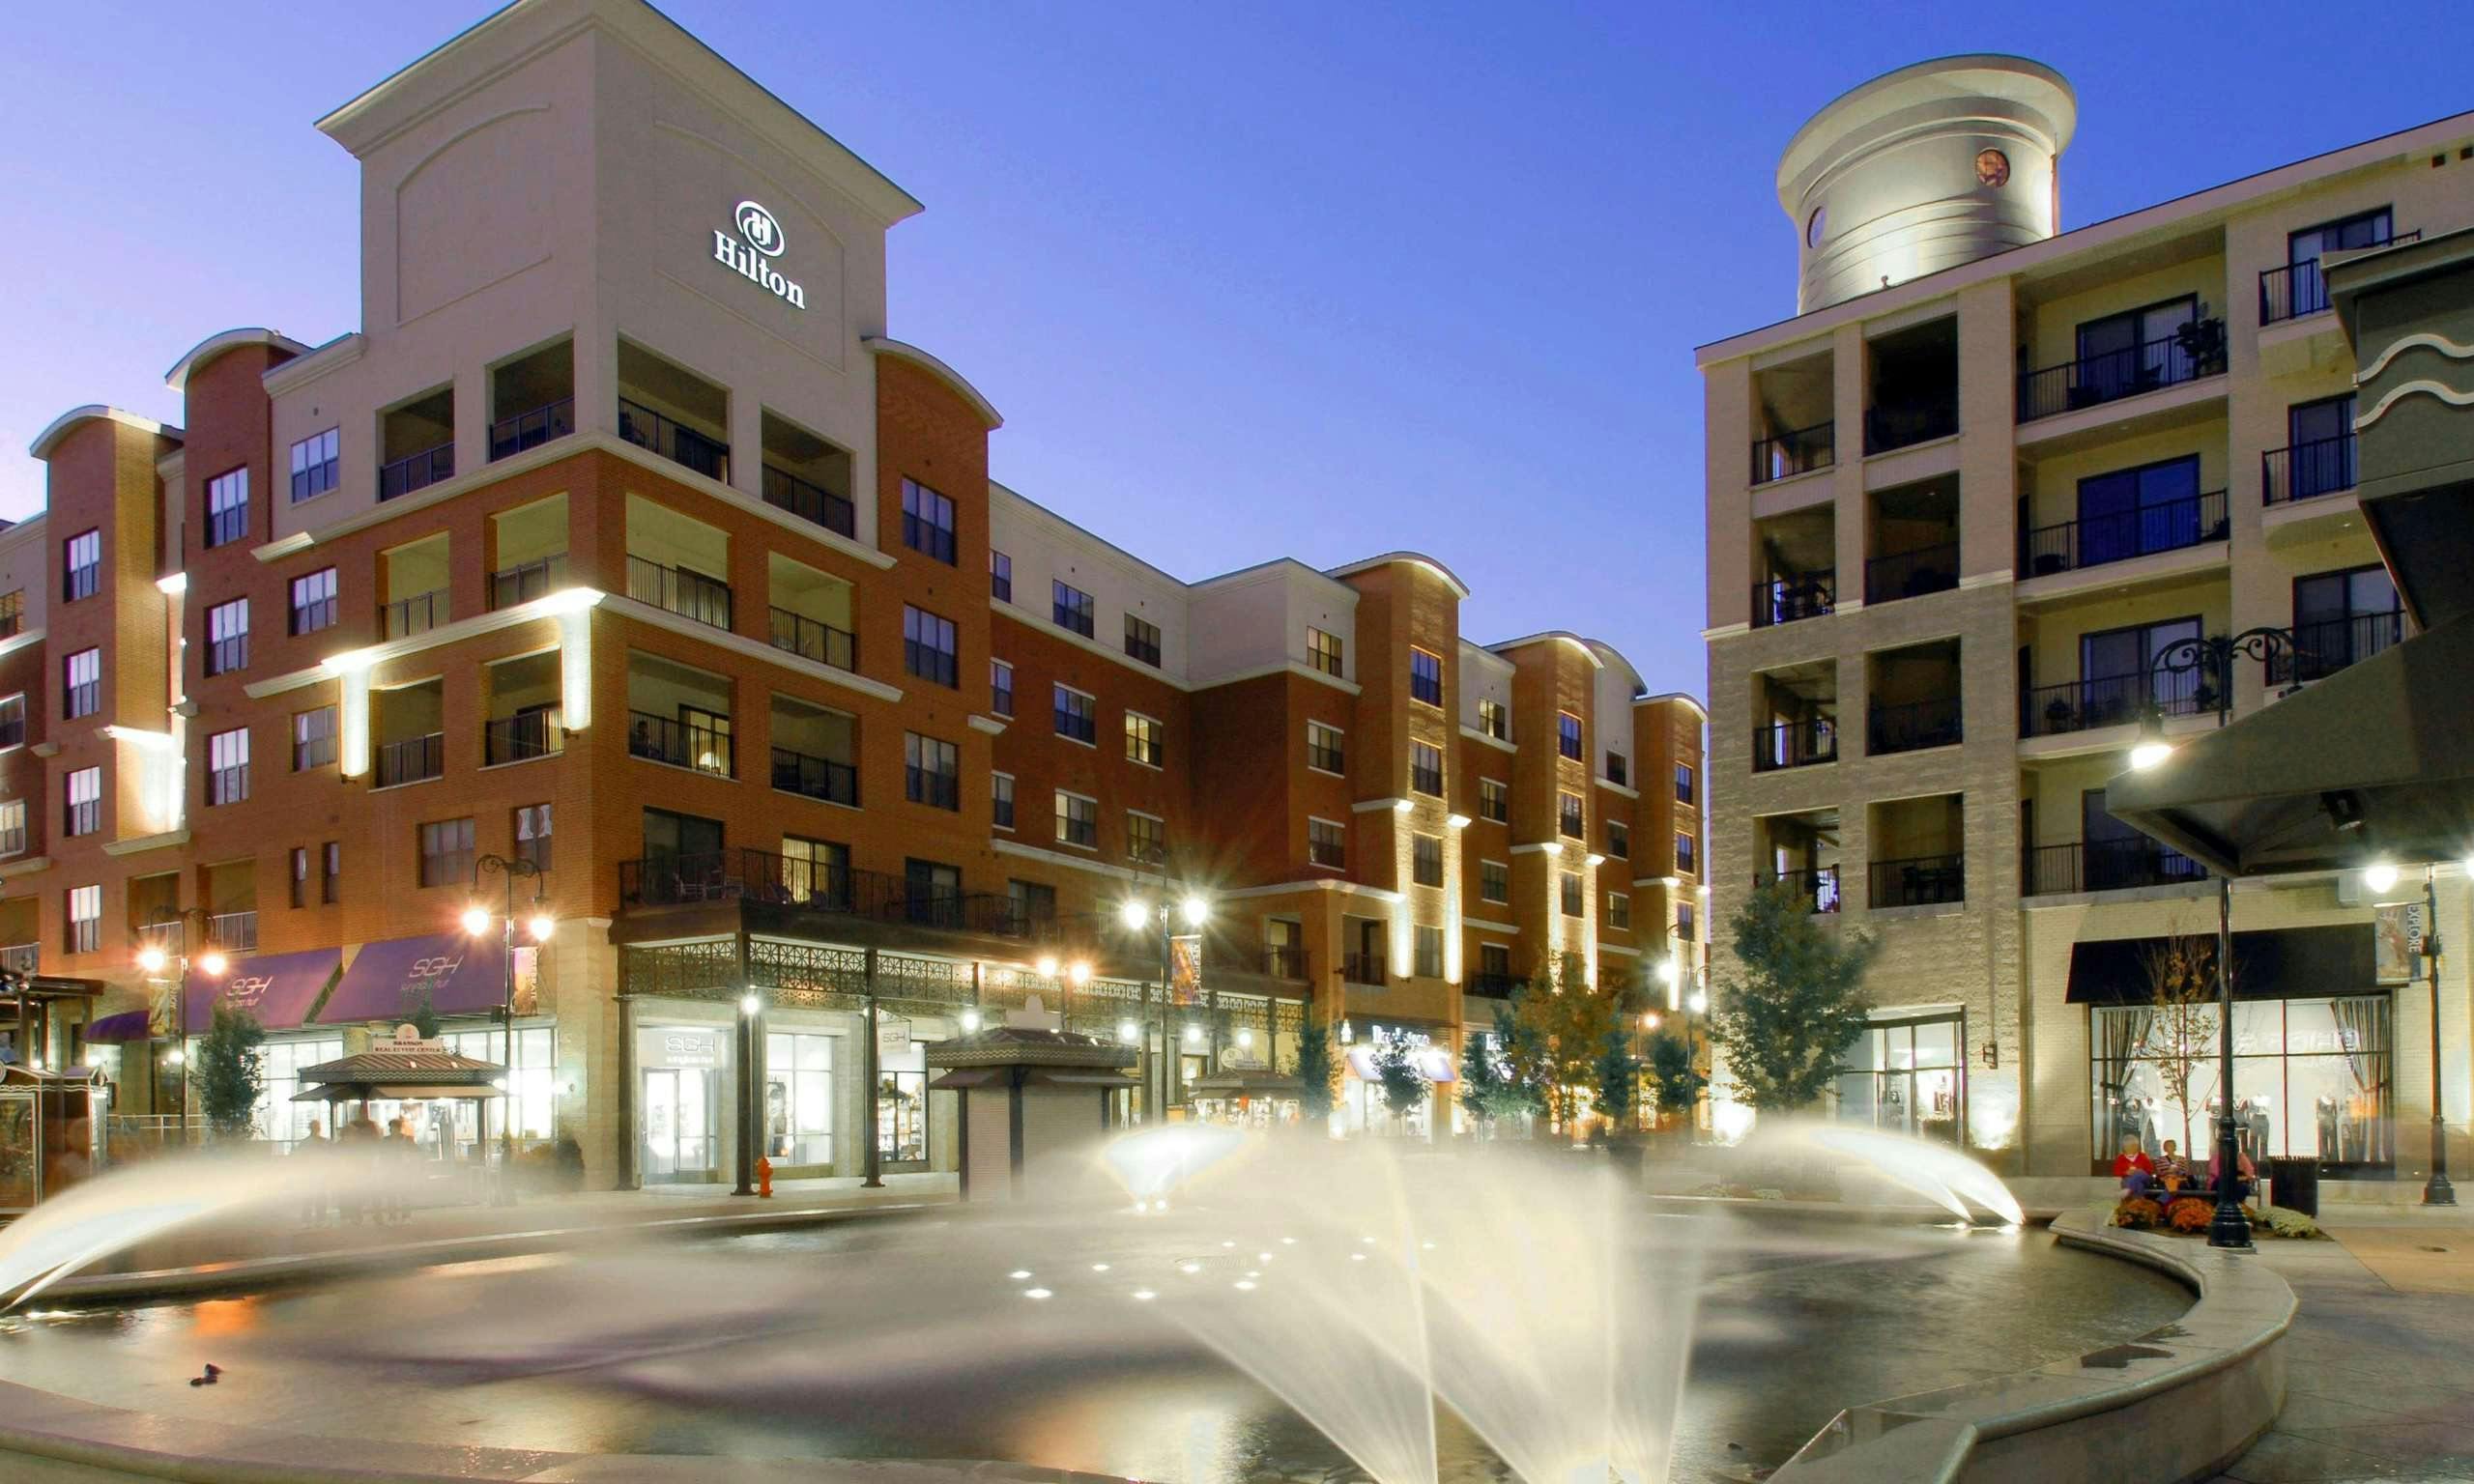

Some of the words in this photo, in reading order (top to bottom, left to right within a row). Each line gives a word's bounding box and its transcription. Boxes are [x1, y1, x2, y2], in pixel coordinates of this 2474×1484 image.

[713, 230, 806, 310] Hilton
[2407, 904, 2421, 953] EXPLORE
[409, 955, 465, 978] SGH
[226, 976, 273, 996] SGH
[667, 1035, 715, 1052] SGH
[882, 1030, 906, 1042] SGH
